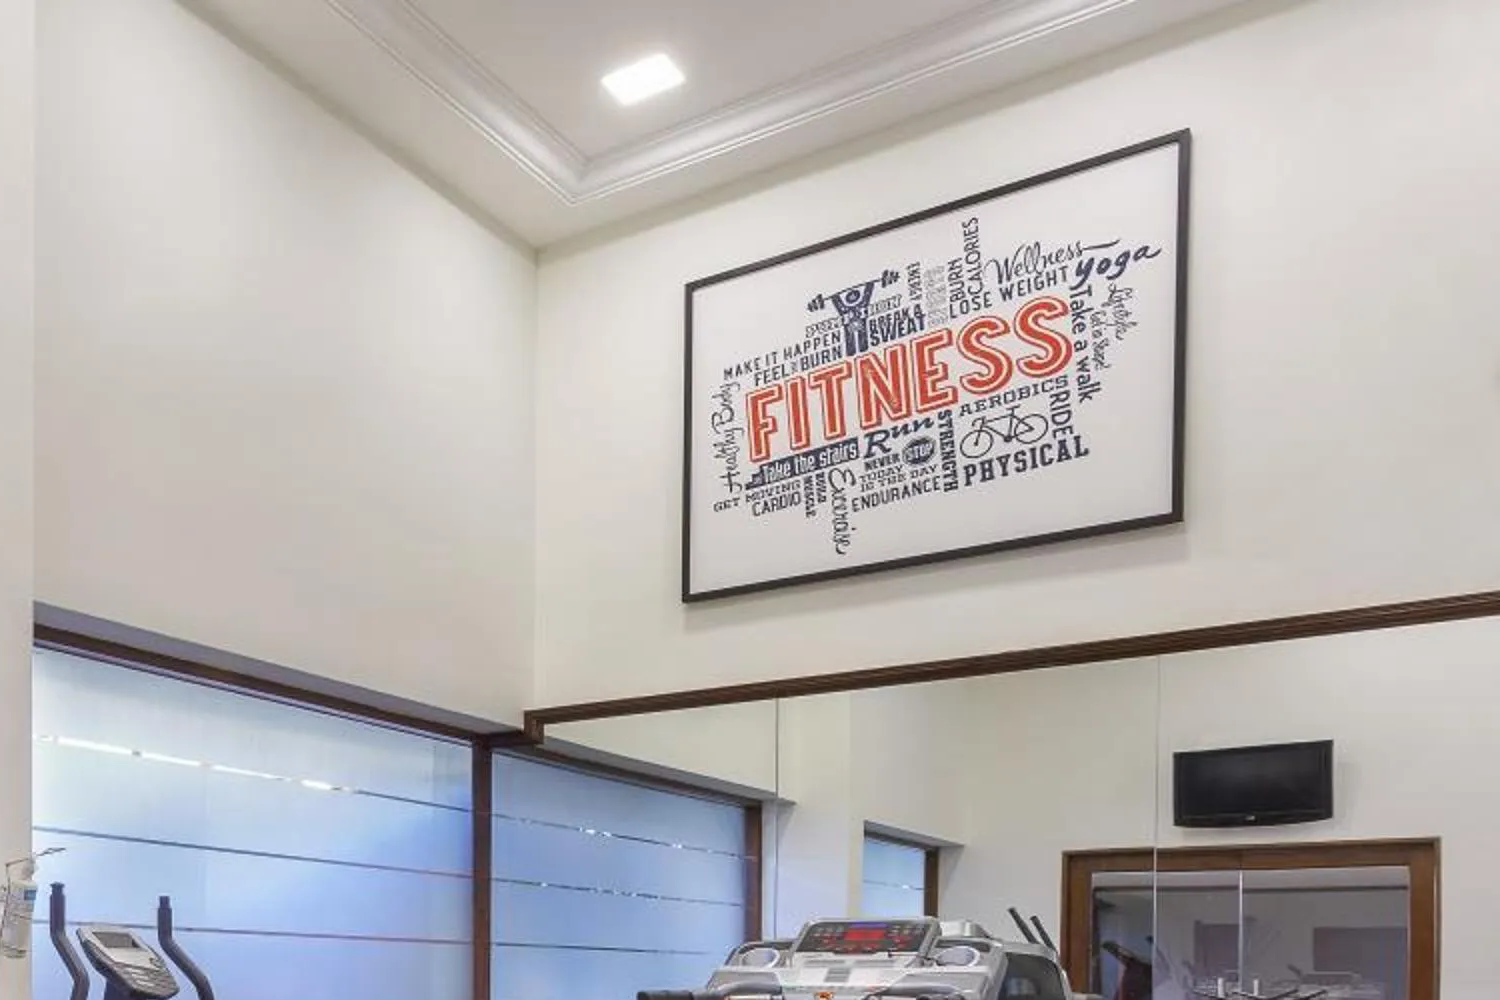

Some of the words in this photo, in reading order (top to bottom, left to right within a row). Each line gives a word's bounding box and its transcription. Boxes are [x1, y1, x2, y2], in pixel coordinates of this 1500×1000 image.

[962, 217, 984, 295] CALORIES
[983, 239, 1120, 284] Wellness
[1070, 245, 1162, 290] yoga
[950, 258, 966, 302] BURN
[950, 292, 992, 318] LOSE
[999, 266, 1069, 301] WEIGHT
[870, 313, 926, 347] SWEAT
[1070, 285, 1092, 335] Take
[723, 357, 760, 380] MAKE
[765, 352, 777, 366] IT
[783, 331, 841, 361] HAPPEN
[755, 364, 791, 386] FEEL
[801, 345, 842, 372] BURN
[1074, 342, 1088, 352] a
[746, 296, 1075, 463] FITNESS
[959, 375, 1068, 417] AEROBICS
[1077, 357, 1101, 403] walk
[711, 381, 740, 434] Body
[1050, 390, 1073, 439] RIDE
[713, 427, 744, 493] Healthy
[864, 418, 934, 459] Run
[938, 410, 958, 493] STRENGTH
[760, 460, 791, 482] Take
[794, 455, 814, 473] the
[819, 442, 857, 468] stairs
[859, 465, 903, 482] TODAY
[864, 454, 899, 472] NEVER
[911, 464, 938, 478] DAY
[964, 435, 1089, 487] PHYSICAL
[713, 498, 740, 513] GET
[746, 479, 800, 503] MOVING
[752, 492, 801, 516] CARDIO
[852, 475, 941, 512] ENDURANCE
